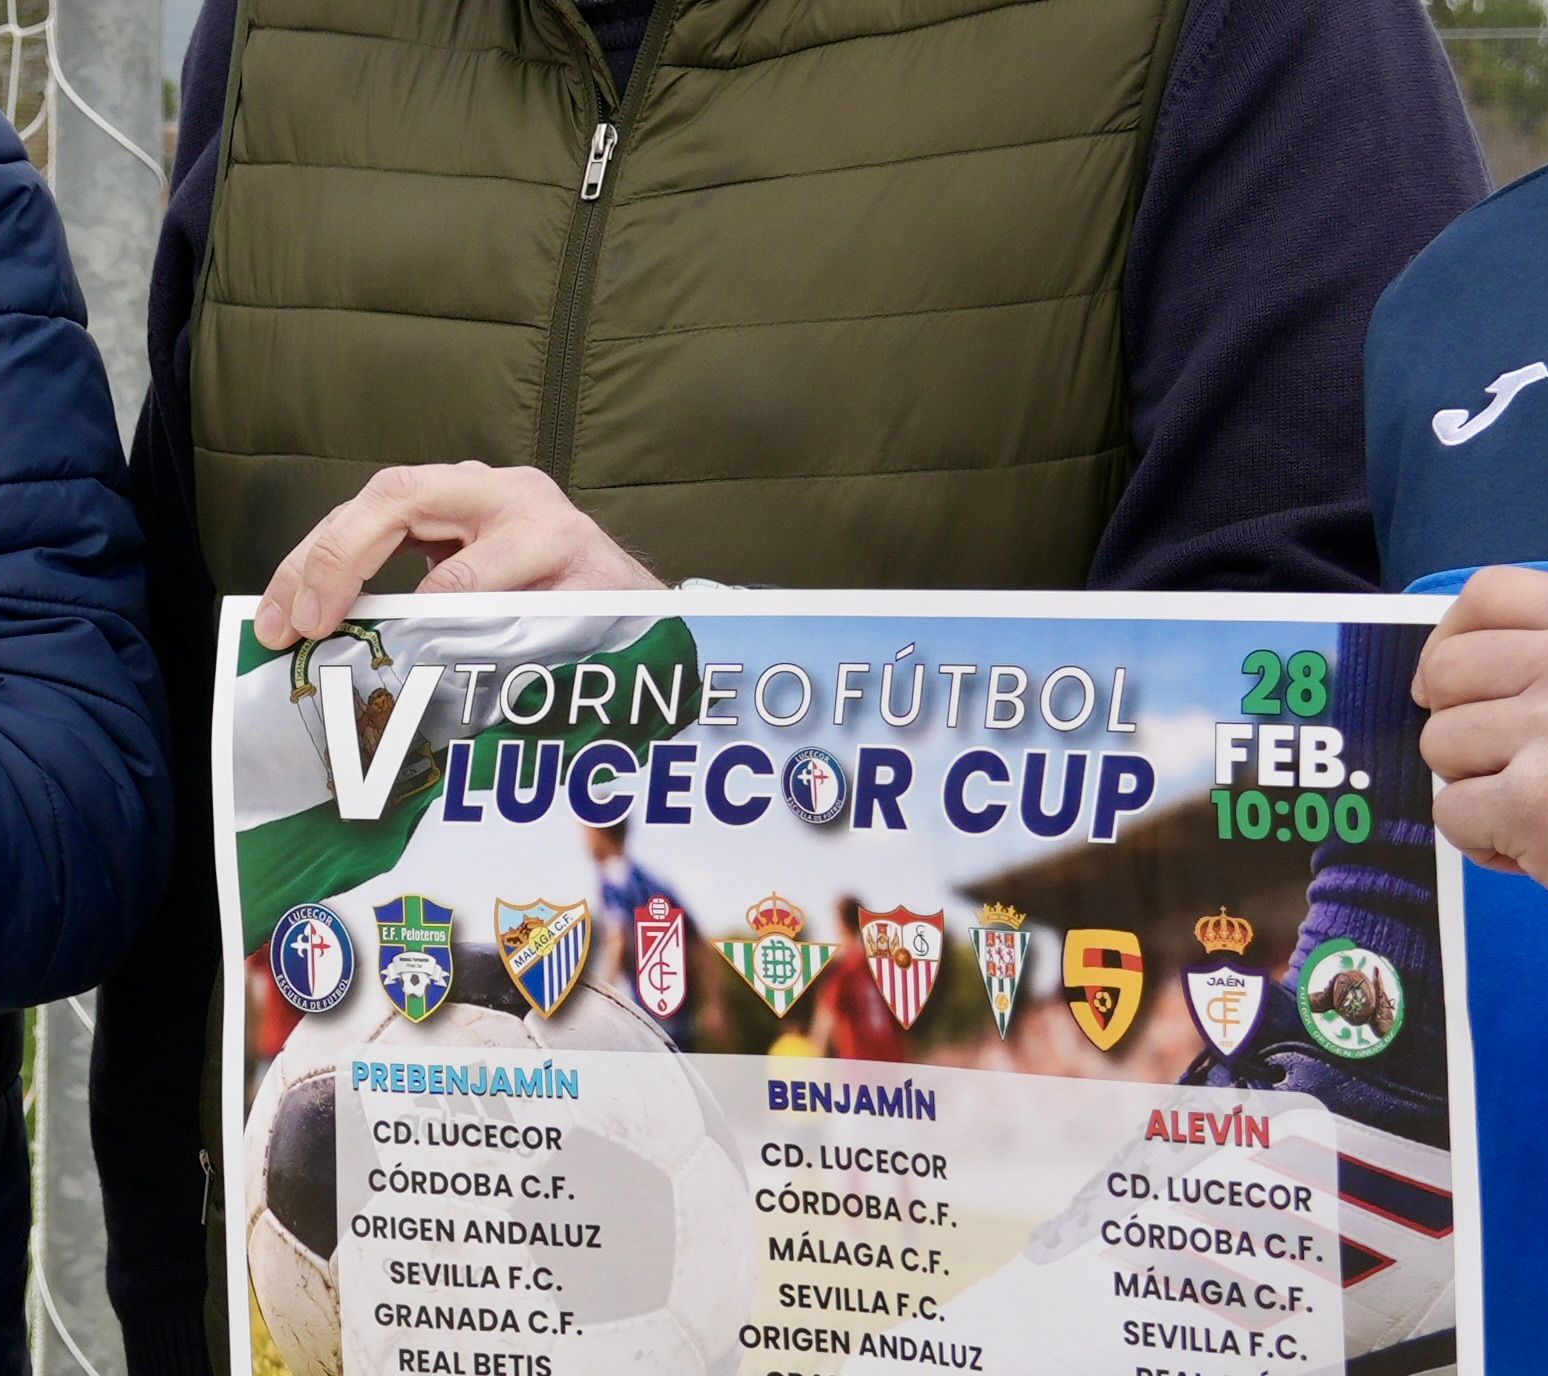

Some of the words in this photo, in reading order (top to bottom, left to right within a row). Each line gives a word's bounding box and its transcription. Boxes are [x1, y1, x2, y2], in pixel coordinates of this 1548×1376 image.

[1240, 649, 1328, 717] 28
[319, 664, 447, 821] V
[453, 663, 812, 726] TORNEO
[833, 641, 1138, 734] FÚTBOL
[1215, 722, 1370, 789] FEB.
[941, 745, 1155, 844] CUP
[1210, 789, 1371, 843] 10:00
[382, 928, 398, 940] E.F.
[401, 928, 445, 942] Peloteros
[1206, 975, 1245, 988] JAÉN
[352, 1059, 579, 1099] PREBENJAMÍN
[768, 1078, 936, 1121] BENJAMÍN
[374, 1120, 419, 1146] CD.
[428, 1123, 562, 1151] LUCECOR
[1144, 1104, 1270, 1148] ALEVÍN
[368, 1163, 513, 1198] CÓRDOBA
[521, 1175, 575, 1200] C.F.
[761, 1143, 812, 1169] CD.
[820, 1146, 947, 1180] LUCECOR
[755, 1183, 902, 1222] CÓRDOBA
[909, 1200, 957, 1228] C.F.
[1107, 1172, 1159, 1200] CD.
[1168, 1177, 1312, 1212] LUCECOR
[352, 1215, 455, 1243] ORIGEN
[463, 1220, 601, 1248] ANDALUZ
[1101, 1214, 1256, 1257] CÓRDOBA
[1264, 1233, 1323, 1262] C.F.
[769, 1231, 894, 1270] MÁLAGA
[901, 1248, 949, 1276] C.F.
[390, 1261, 499, 1289] SEVILLA
[509, 1267, 562, 1292] F.C.
[1114, 1267, 1246, 1308] MÁLAGA
[1254, 1283, 1313, 1313] C.F.
[375, 1303, 520, 1333] GRANADA
[528, 1310, 583, 1336] C.F.
[779, 1284, 889, 1315] SEVILLA
[897, 1293, 945, 1322] F.C.
[739, 1325, 850, 1354] ORIGEN
[859, 1333, 983, 1371] ANDALUZ
[1123, 1321, 1240, 1356] SEVILLA
[1249, 1331, 1307, 1361] F.C.
[399, 1349, 466, 1375] REAL
